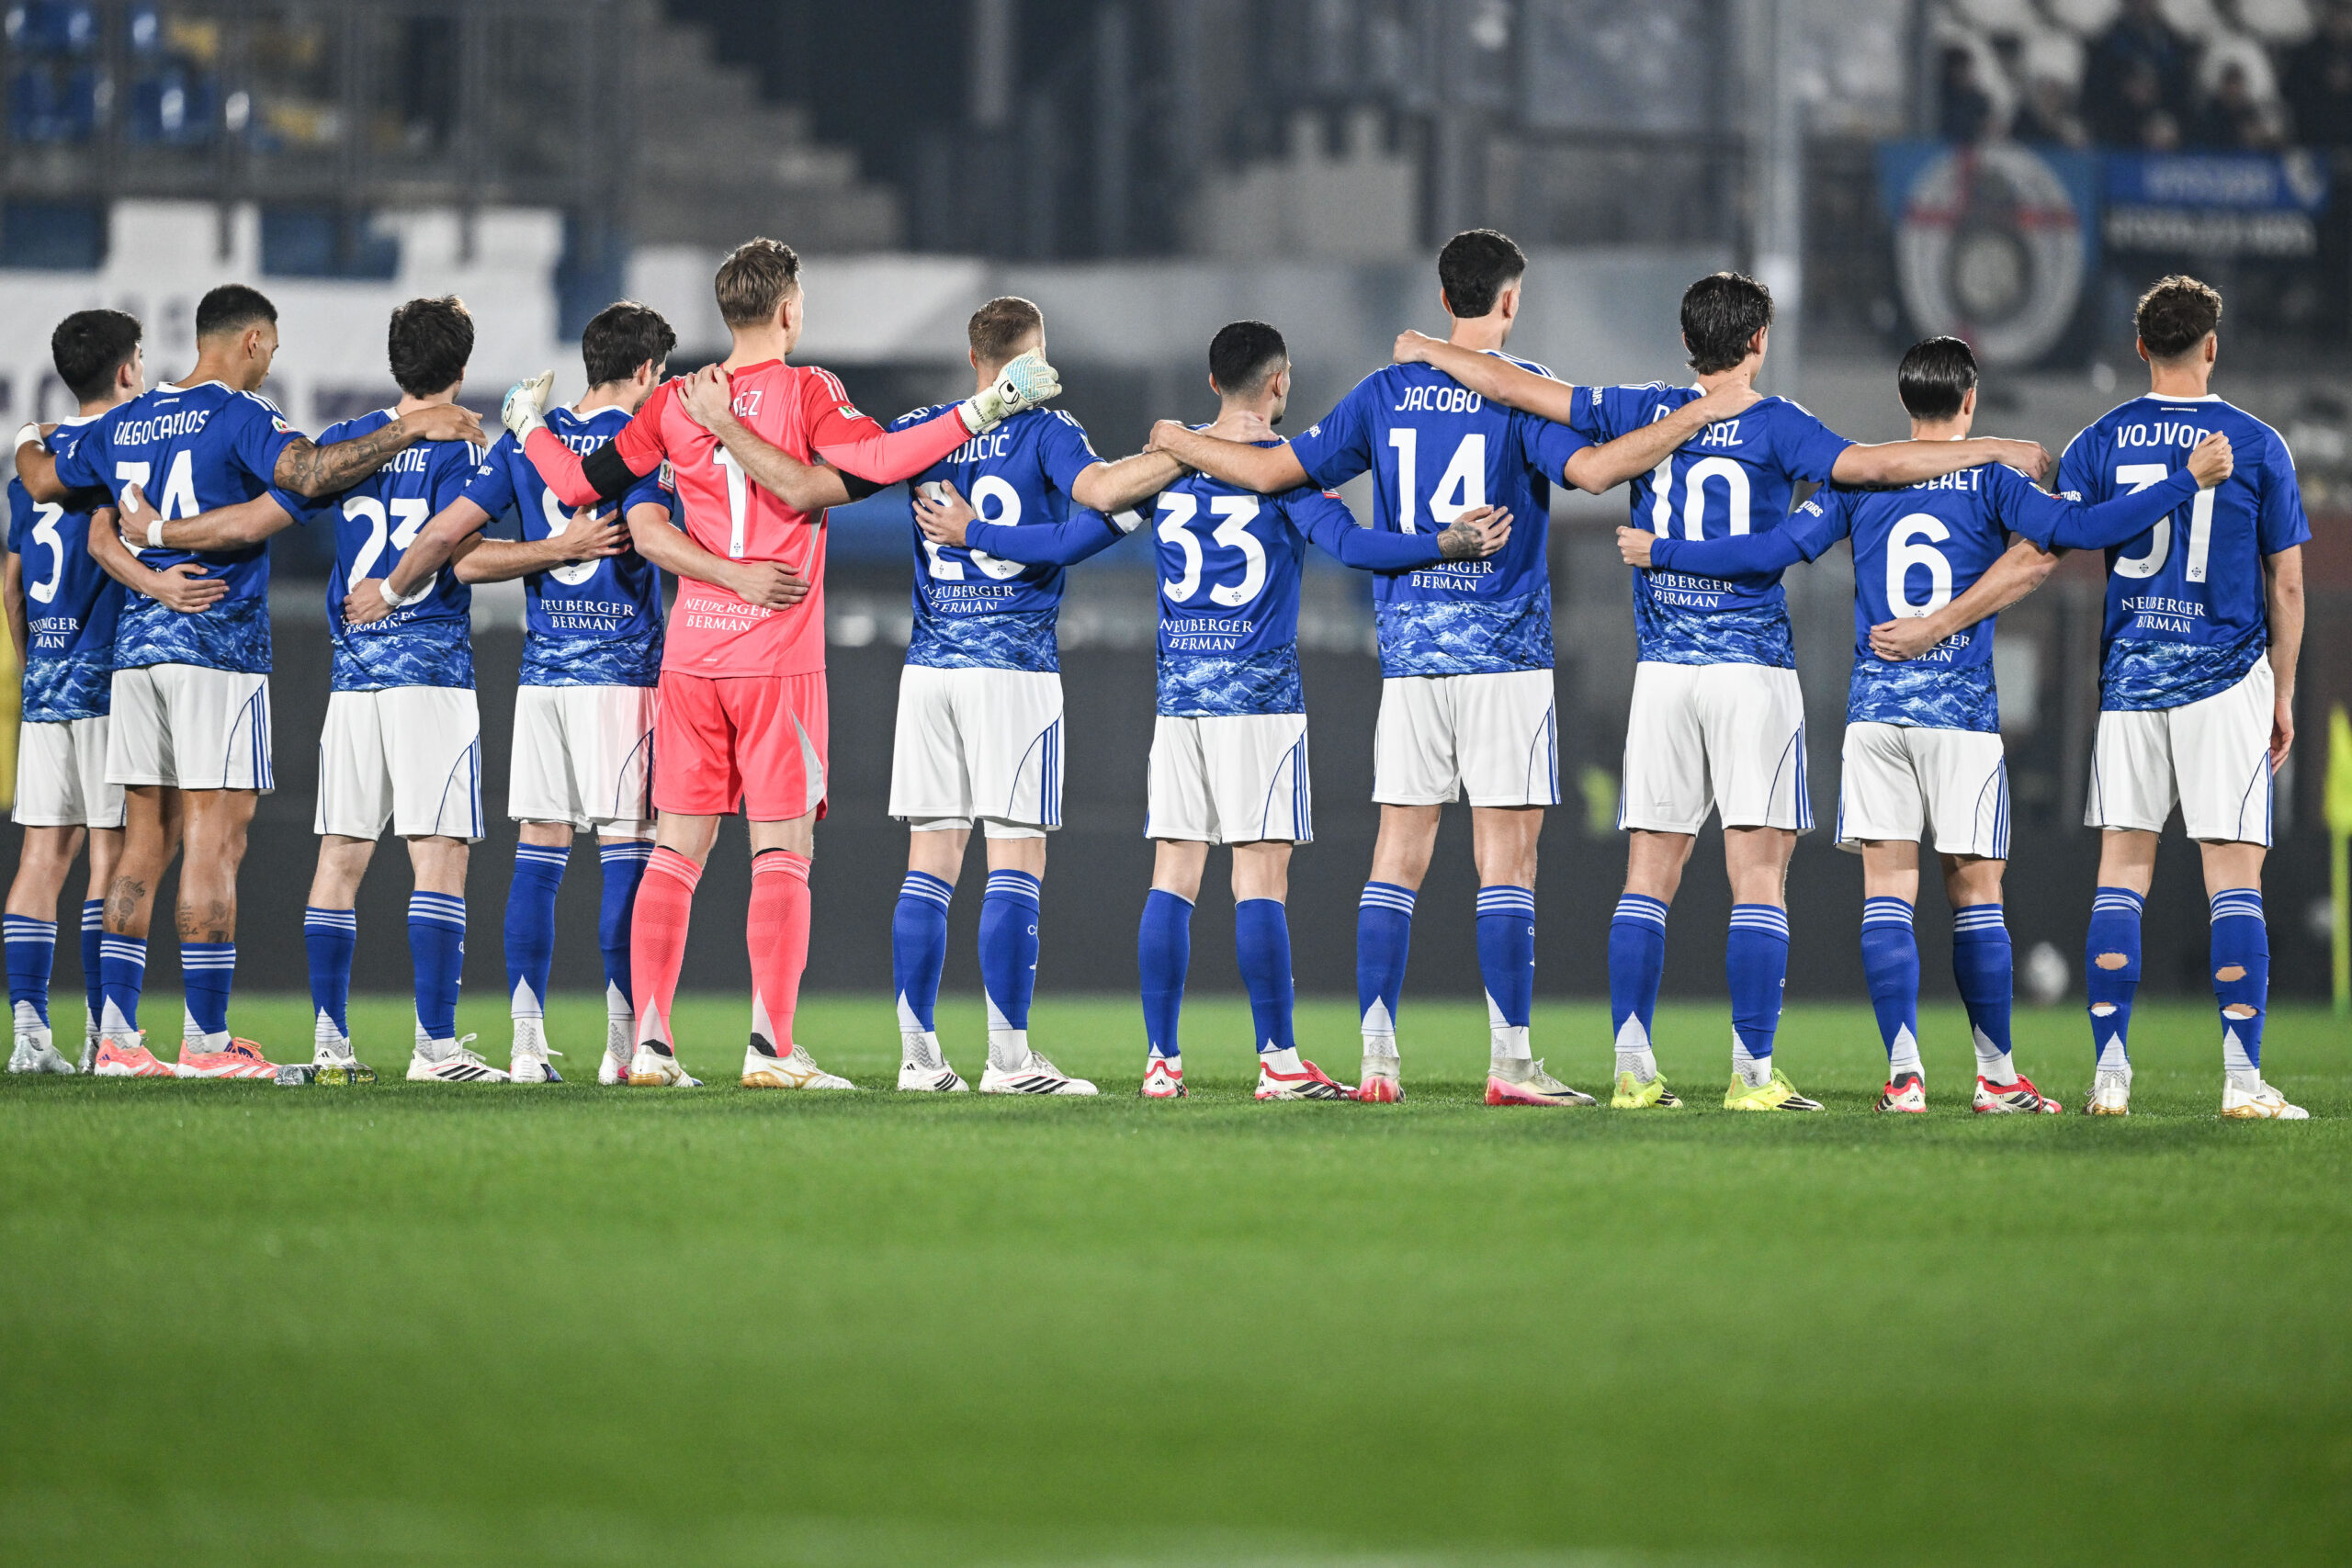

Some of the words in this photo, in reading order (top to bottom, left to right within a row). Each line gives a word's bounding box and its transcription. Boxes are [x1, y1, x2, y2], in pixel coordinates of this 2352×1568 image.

[1395, 386, 1482, 413] JACOBO
[2118, 422, 2211, 451] VOJVOD
[1389, 427, 1494, 535] 14
[713, 446, 747, 558] 1
[1652, 452, 1750, 542] 10
[919, 475, 1028, 581] 28
[2114, 464, 2215, 583] 31
[29, 502, 63, 604] 3
[343, 495, 438, 606] 23
[1157, 491, 1266, 606] 33
[1887, 513, 1952, 619] 6
[922, 584, 1016, 599] NEUBERGER
[1411, 574, 1477, 592] BERMAN
[930, 601, 998, 614] BERMAN
[1654, 589, 1719, 608] BERMAN
[2121, 596, 2205, 616] NEUBERGER
[552, 615, 617, 632] BERMAN
[685, 615, 752, 631] BERMAN
[1159, 617, 1253, 633] NEUBERGER
[1169, 637, 1237, 650] BERMAN
